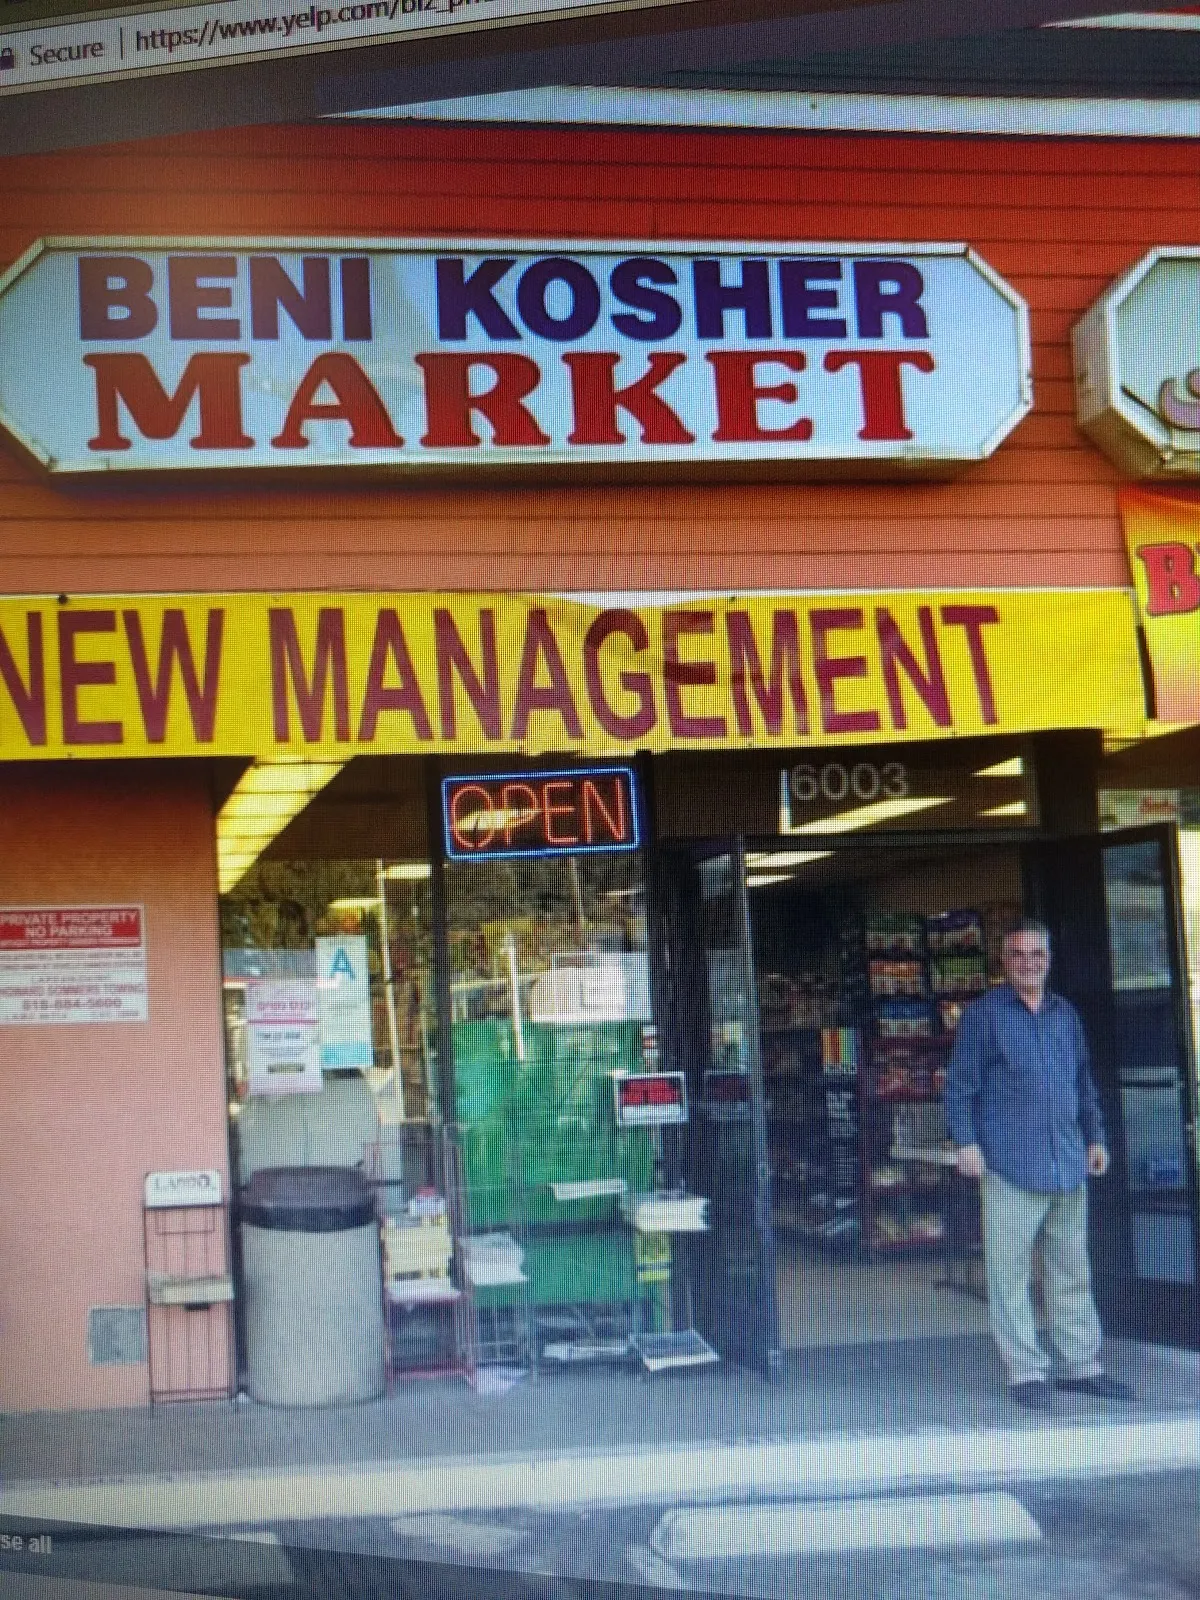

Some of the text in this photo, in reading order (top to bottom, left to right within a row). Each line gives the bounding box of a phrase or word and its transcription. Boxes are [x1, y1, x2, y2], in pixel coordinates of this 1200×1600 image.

[30, 41, 104, 66] Secure
[77, 255, 930, 342] BENI KOSHER
[82, 350, 936, 451] MARKET
[0, 604, 1001, 746] NEW MANAGEMENT
[790, 762, 909, 801] 6003
[451, 776, 627, 849] OPEN
[0, 910, 138, 926] PRIVATE PROPERTY
[25, 924, 113, 938] NO PARKING
[329, 947, 356, 980] A
[28, 1534, 52, 1554] all
